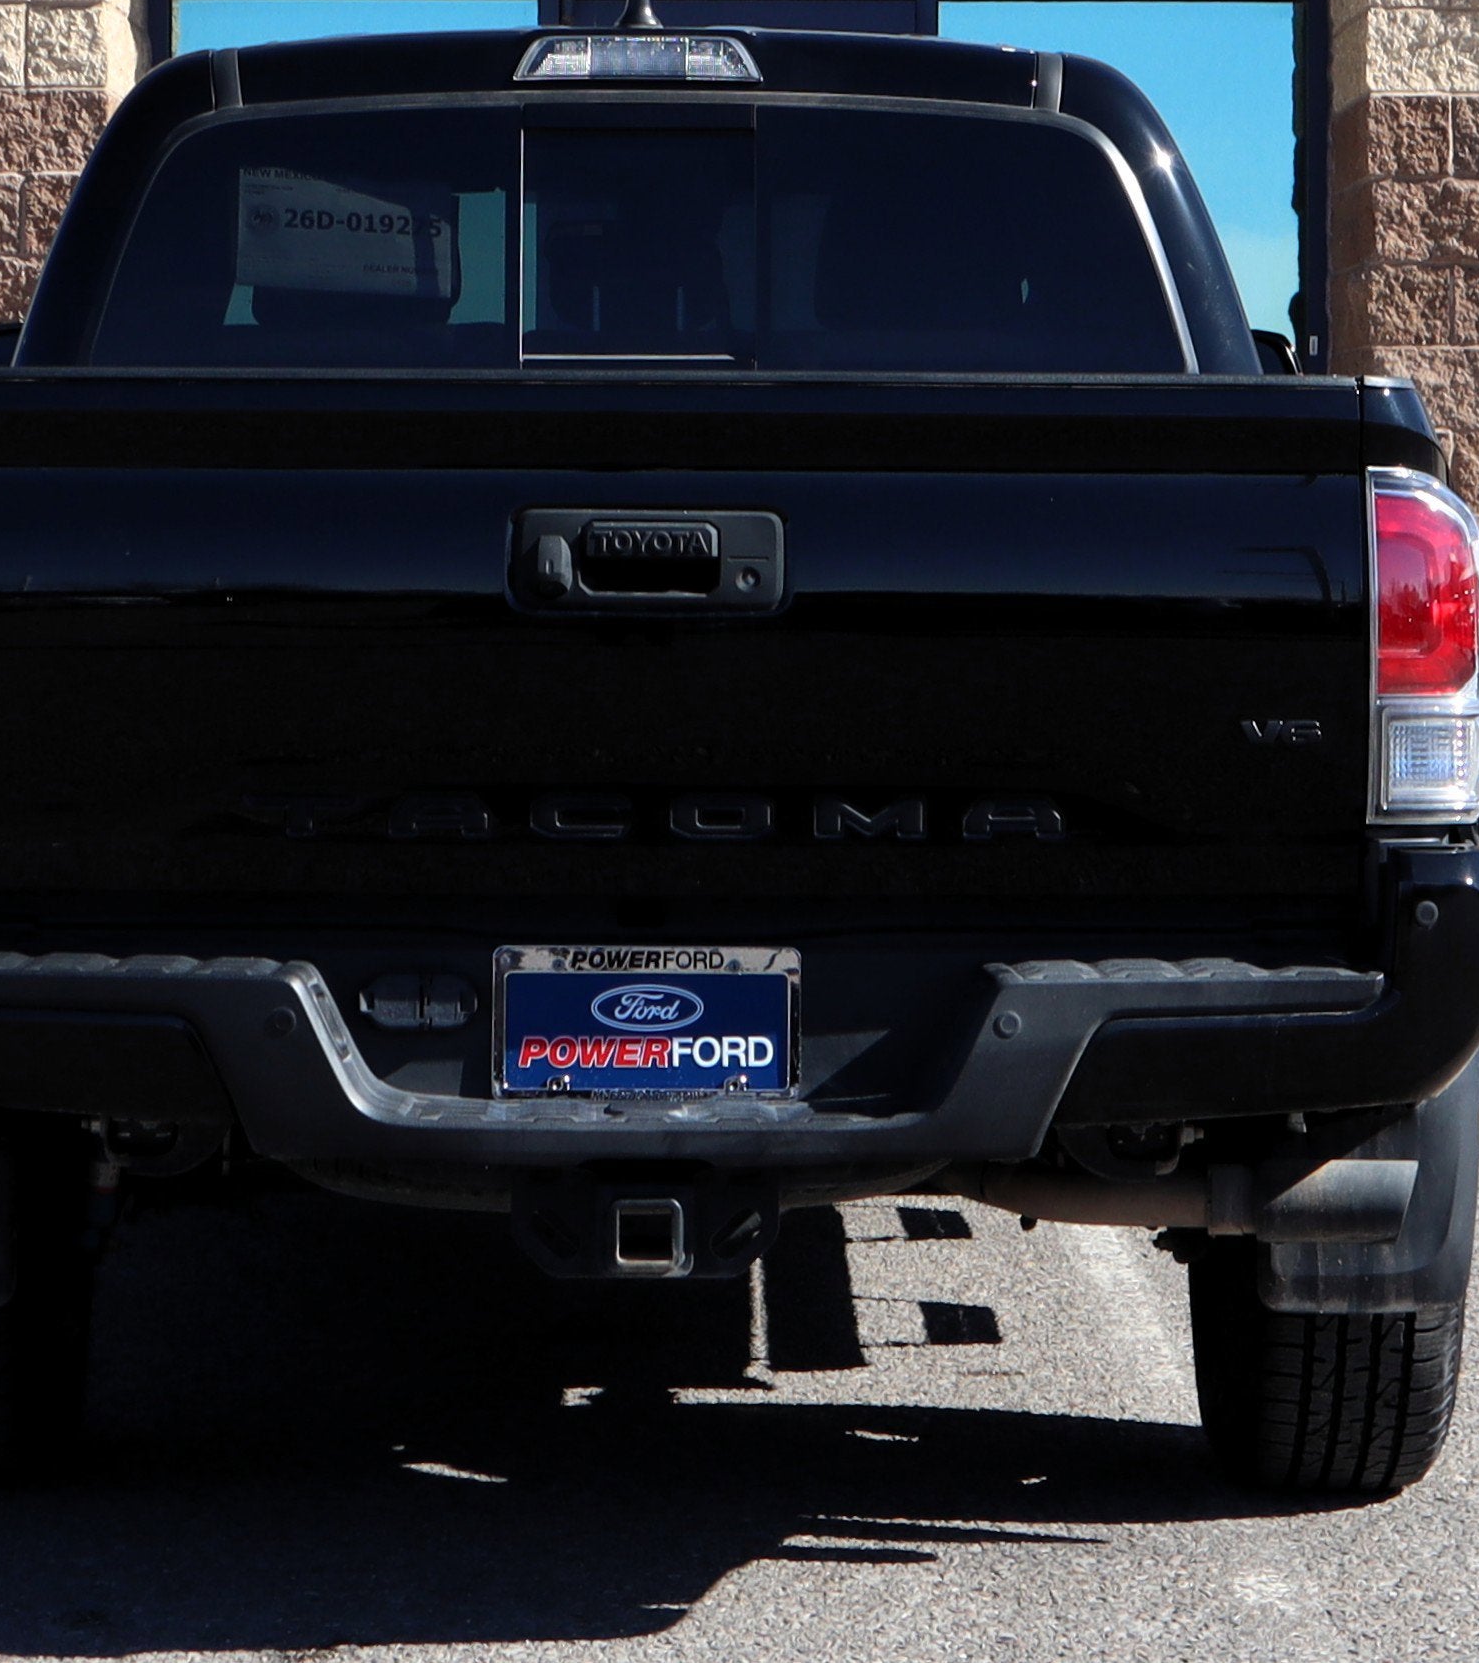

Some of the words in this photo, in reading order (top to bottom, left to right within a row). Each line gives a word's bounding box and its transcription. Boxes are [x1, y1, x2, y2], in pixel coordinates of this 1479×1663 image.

[242, 167, 271, 178] NEW
[594, 530, 710, 554] TOYOTA
[1239, 717, 1323, 745] V6
[241, 792, 1066, 841] TACOMA
[569, 950, 725, 971] POWERFORD
[613, 992, 680, 1021] Ford
[518, 1036, 774, 1069] POWERFORD
